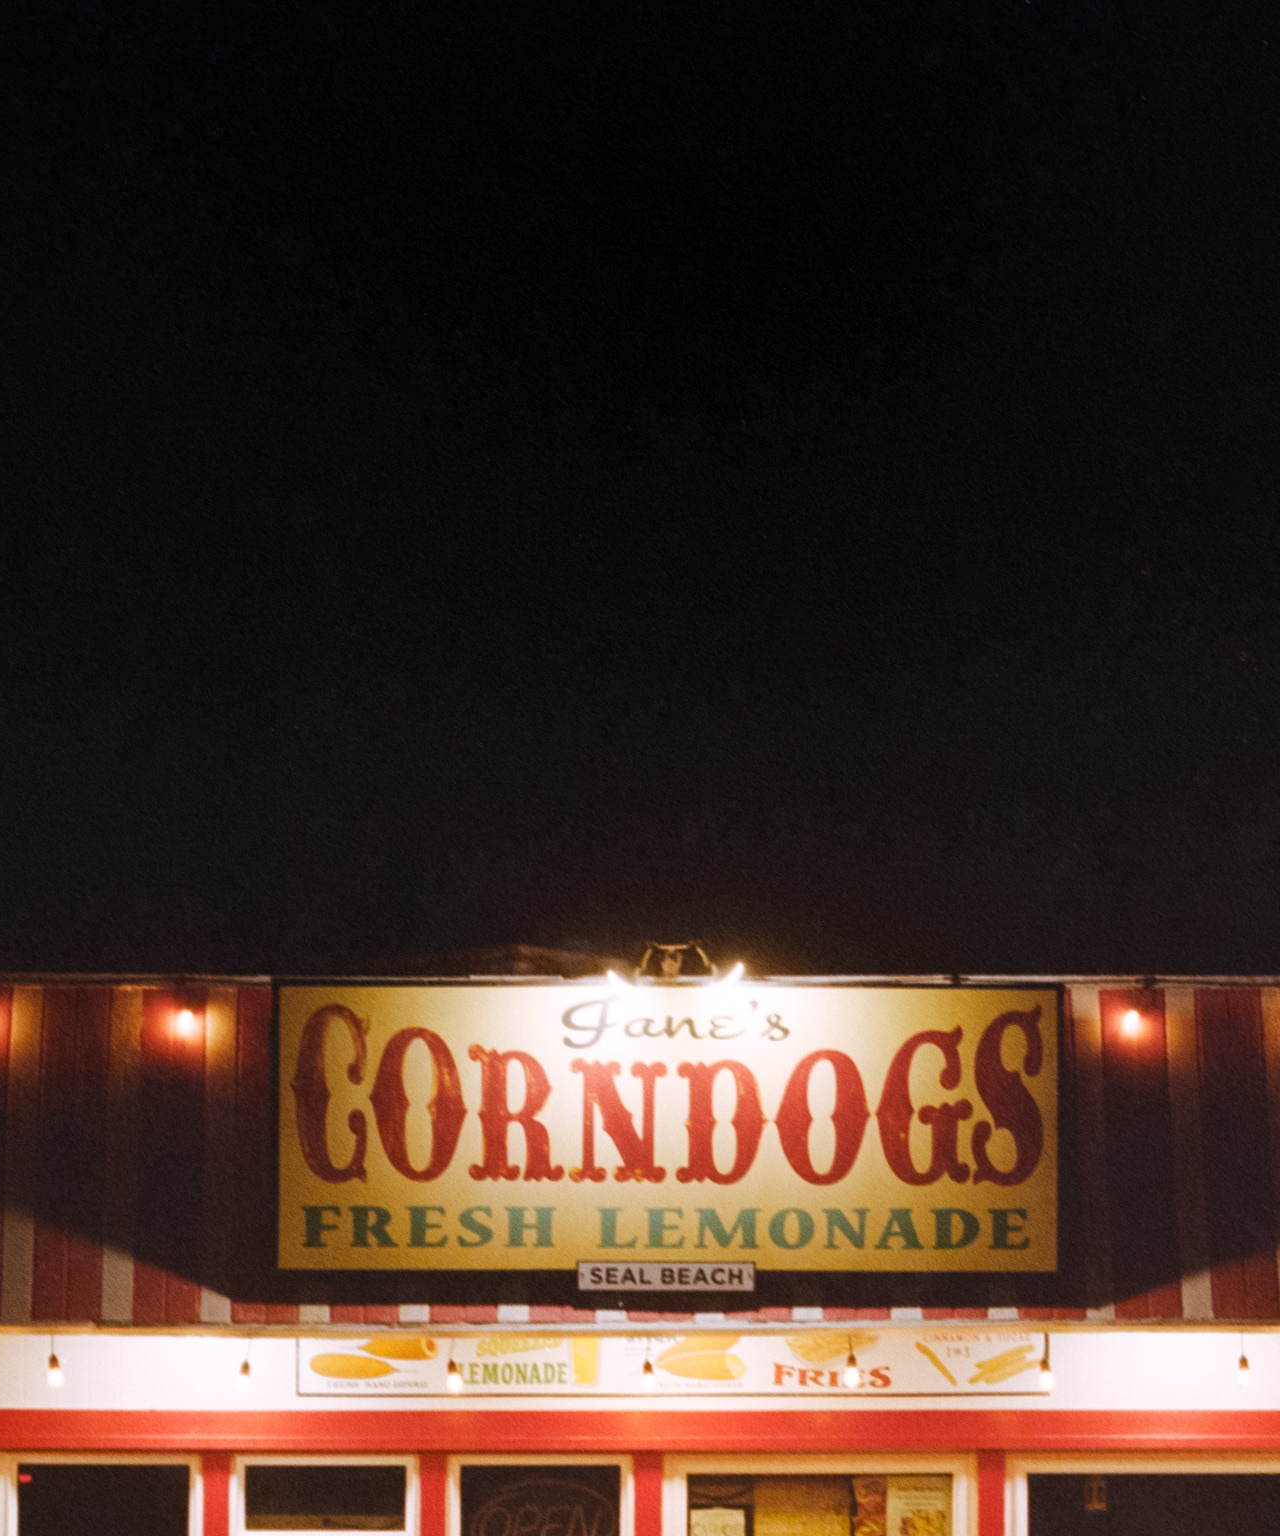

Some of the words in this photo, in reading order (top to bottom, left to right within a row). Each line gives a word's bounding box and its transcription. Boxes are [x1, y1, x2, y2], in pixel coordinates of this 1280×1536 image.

[560, 998, 791, 1050] Jane's
[290, 1001, 1046, 1187] CORNDOGS
[301, 1204, 555, 1250] FRESH
[596, 1206, 1032, 1251] LEMONADE
[589, 1266, 652, 1287] SEAL
[658, 1266, 745, 1287] BEACH
[773, 1363, 892, 1389] FRIS
